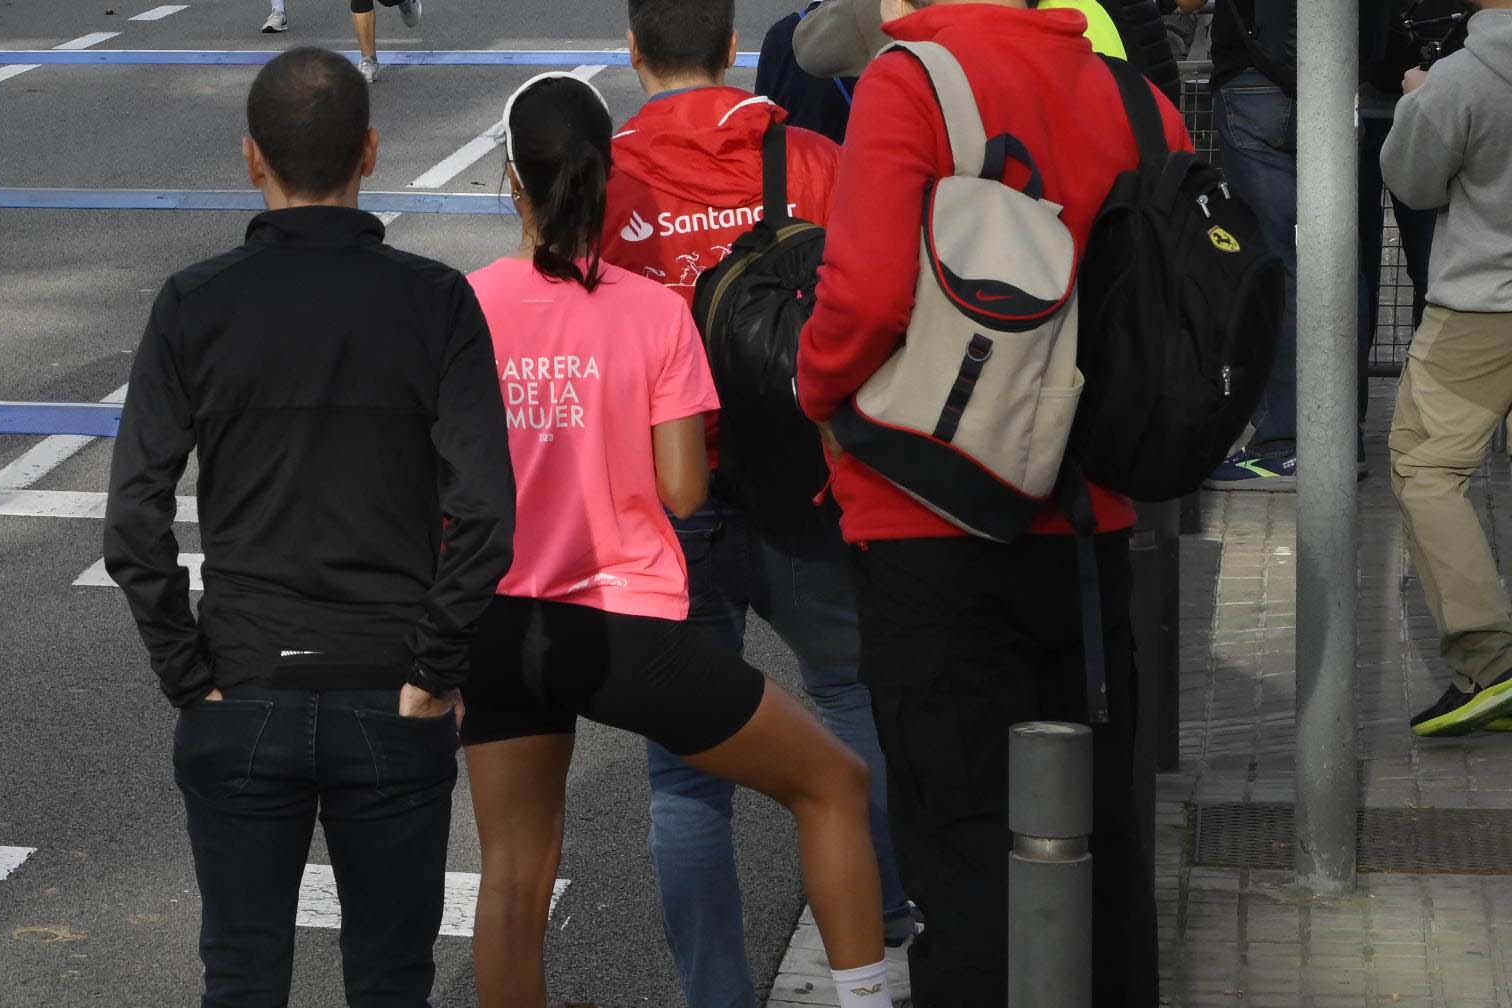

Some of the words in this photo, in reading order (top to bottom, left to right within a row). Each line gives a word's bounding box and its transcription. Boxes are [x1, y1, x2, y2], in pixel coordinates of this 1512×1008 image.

[657, 202, 797, 238] Santanr
[508, 381, 539, 405] DE
[549, 380, 579, 404] LA
[505, 404, 586, 430] MUJER
